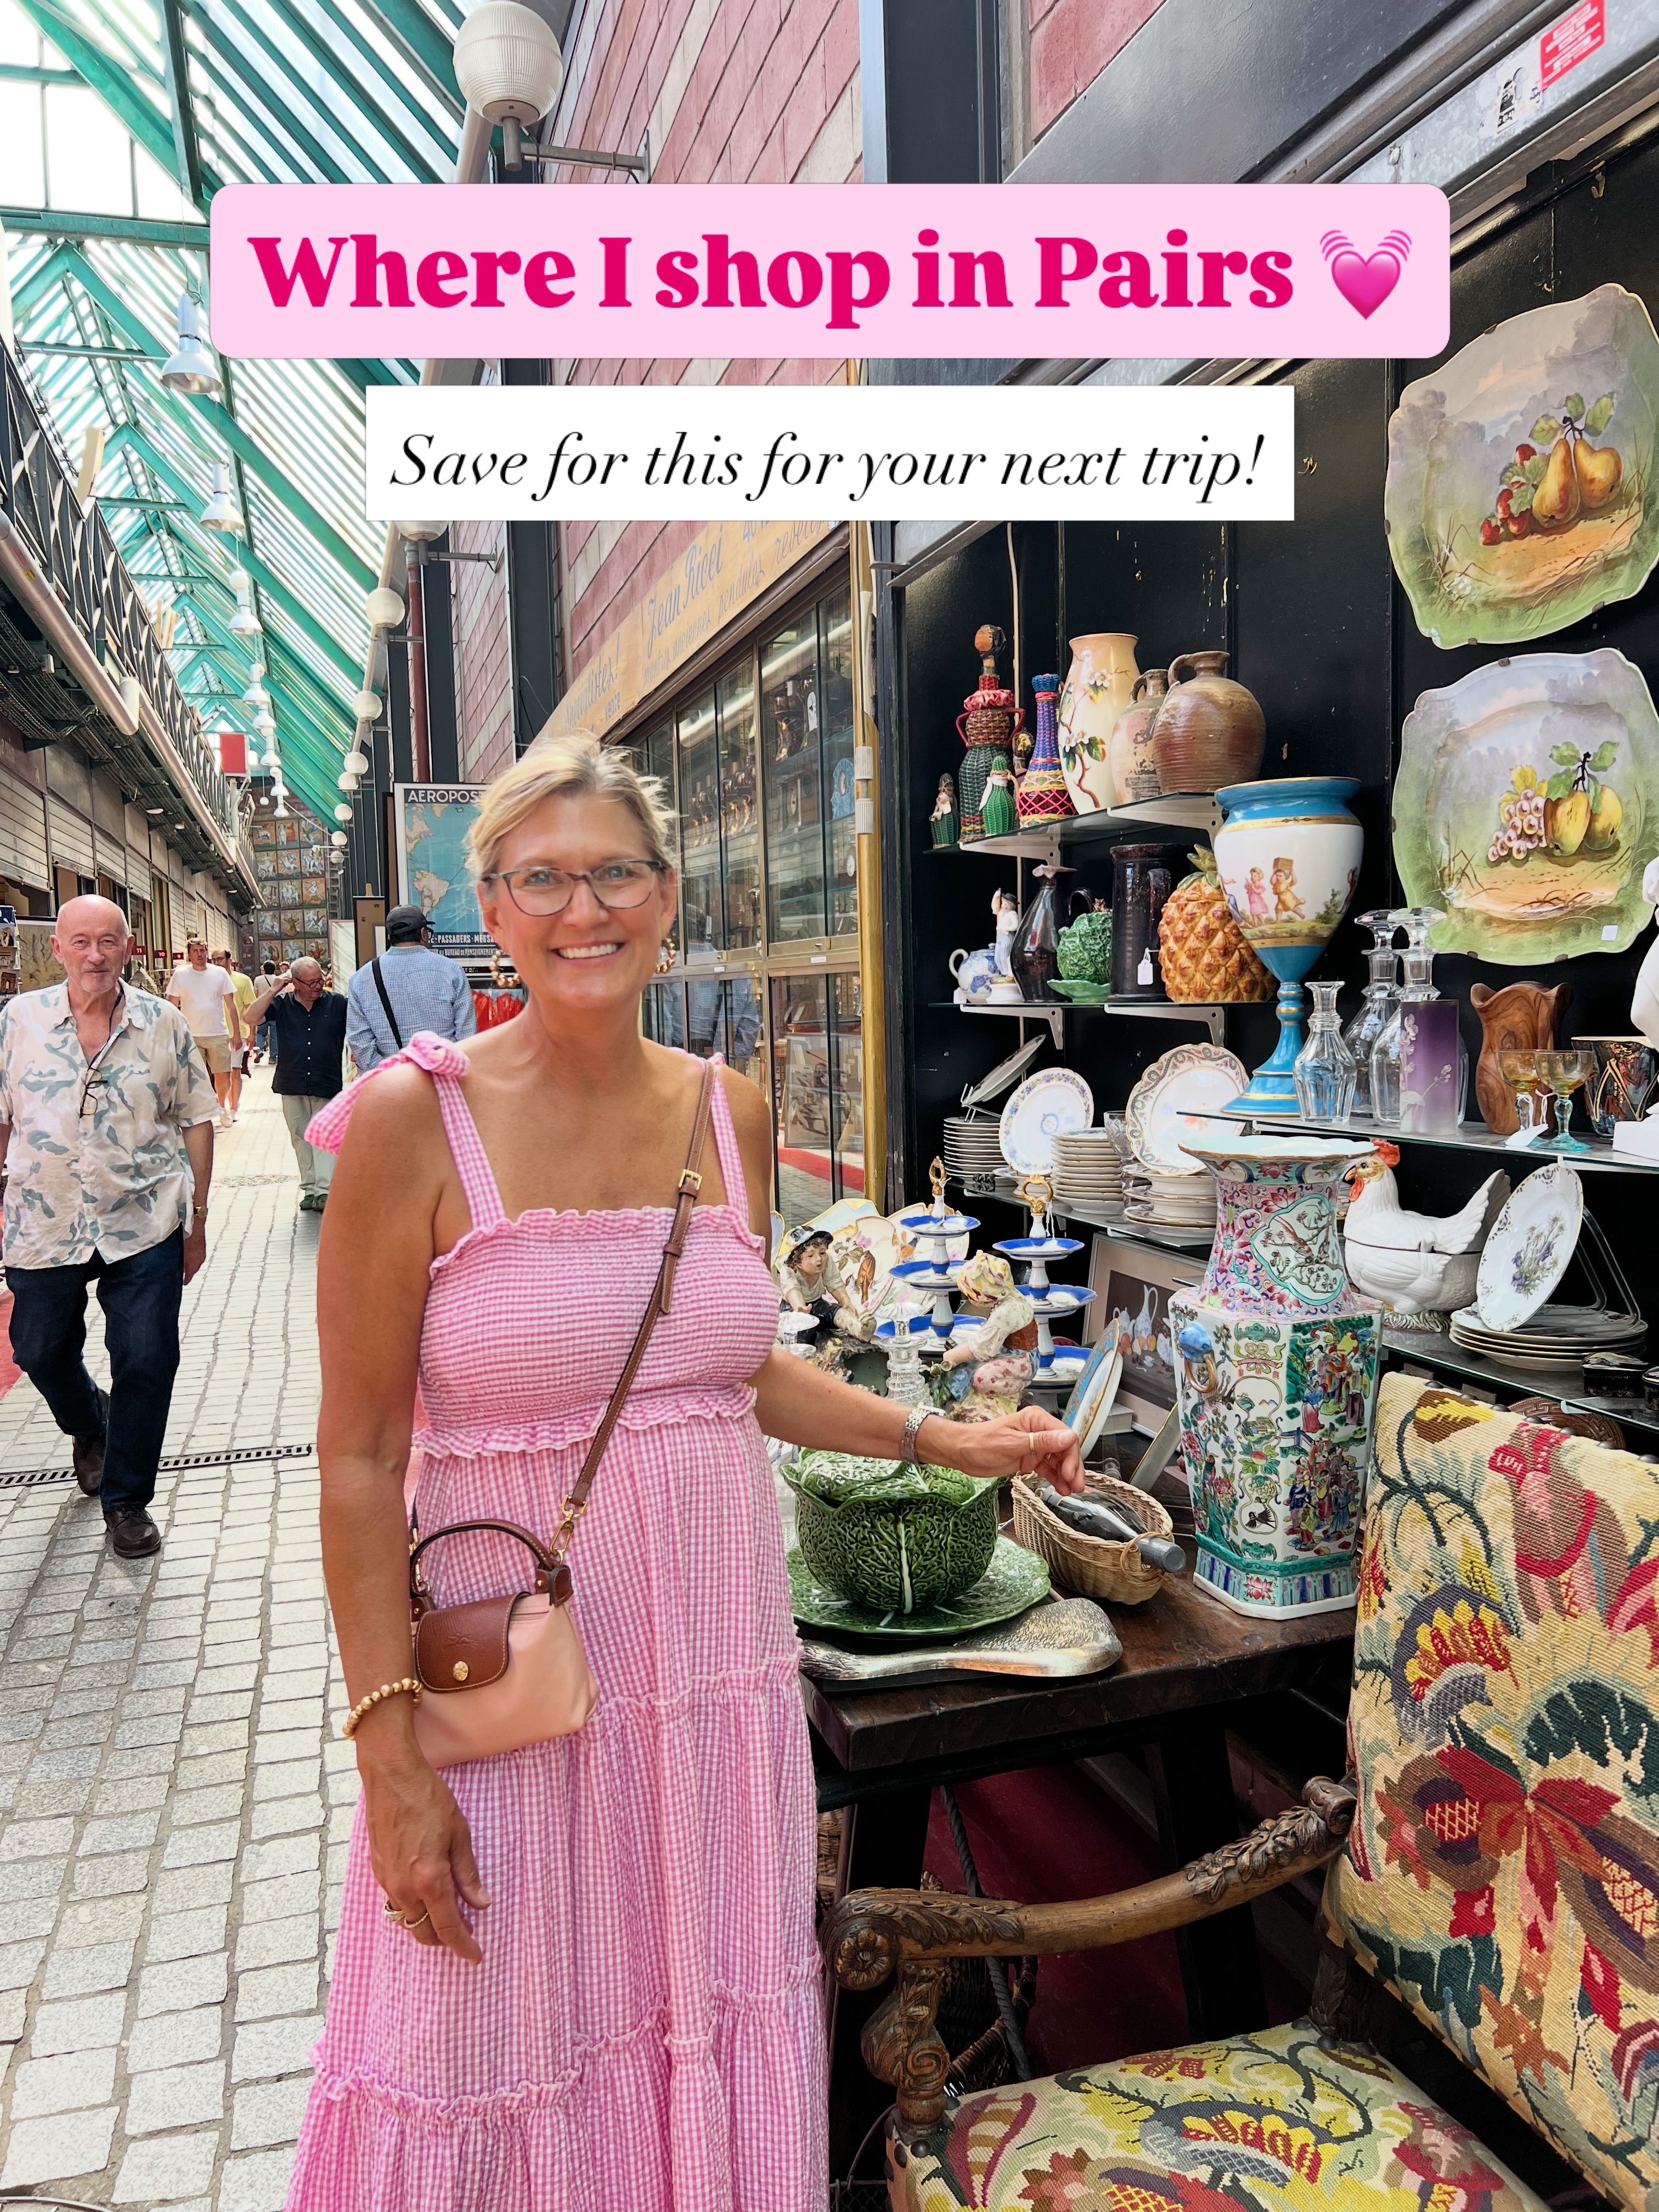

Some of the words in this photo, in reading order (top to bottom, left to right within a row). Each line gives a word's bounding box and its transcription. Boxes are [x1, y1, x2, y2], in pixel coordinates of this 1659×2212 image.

[648, 584, 680, 659] Jean
[683, 522, 723, 610] Ricci
[718, 550, 765, 627] pendules
[605, 690, 620, 722] vente
[465, 948, 498, 956] RENSEIGNEMENT
[474, 934, 494, 943] MESSA
